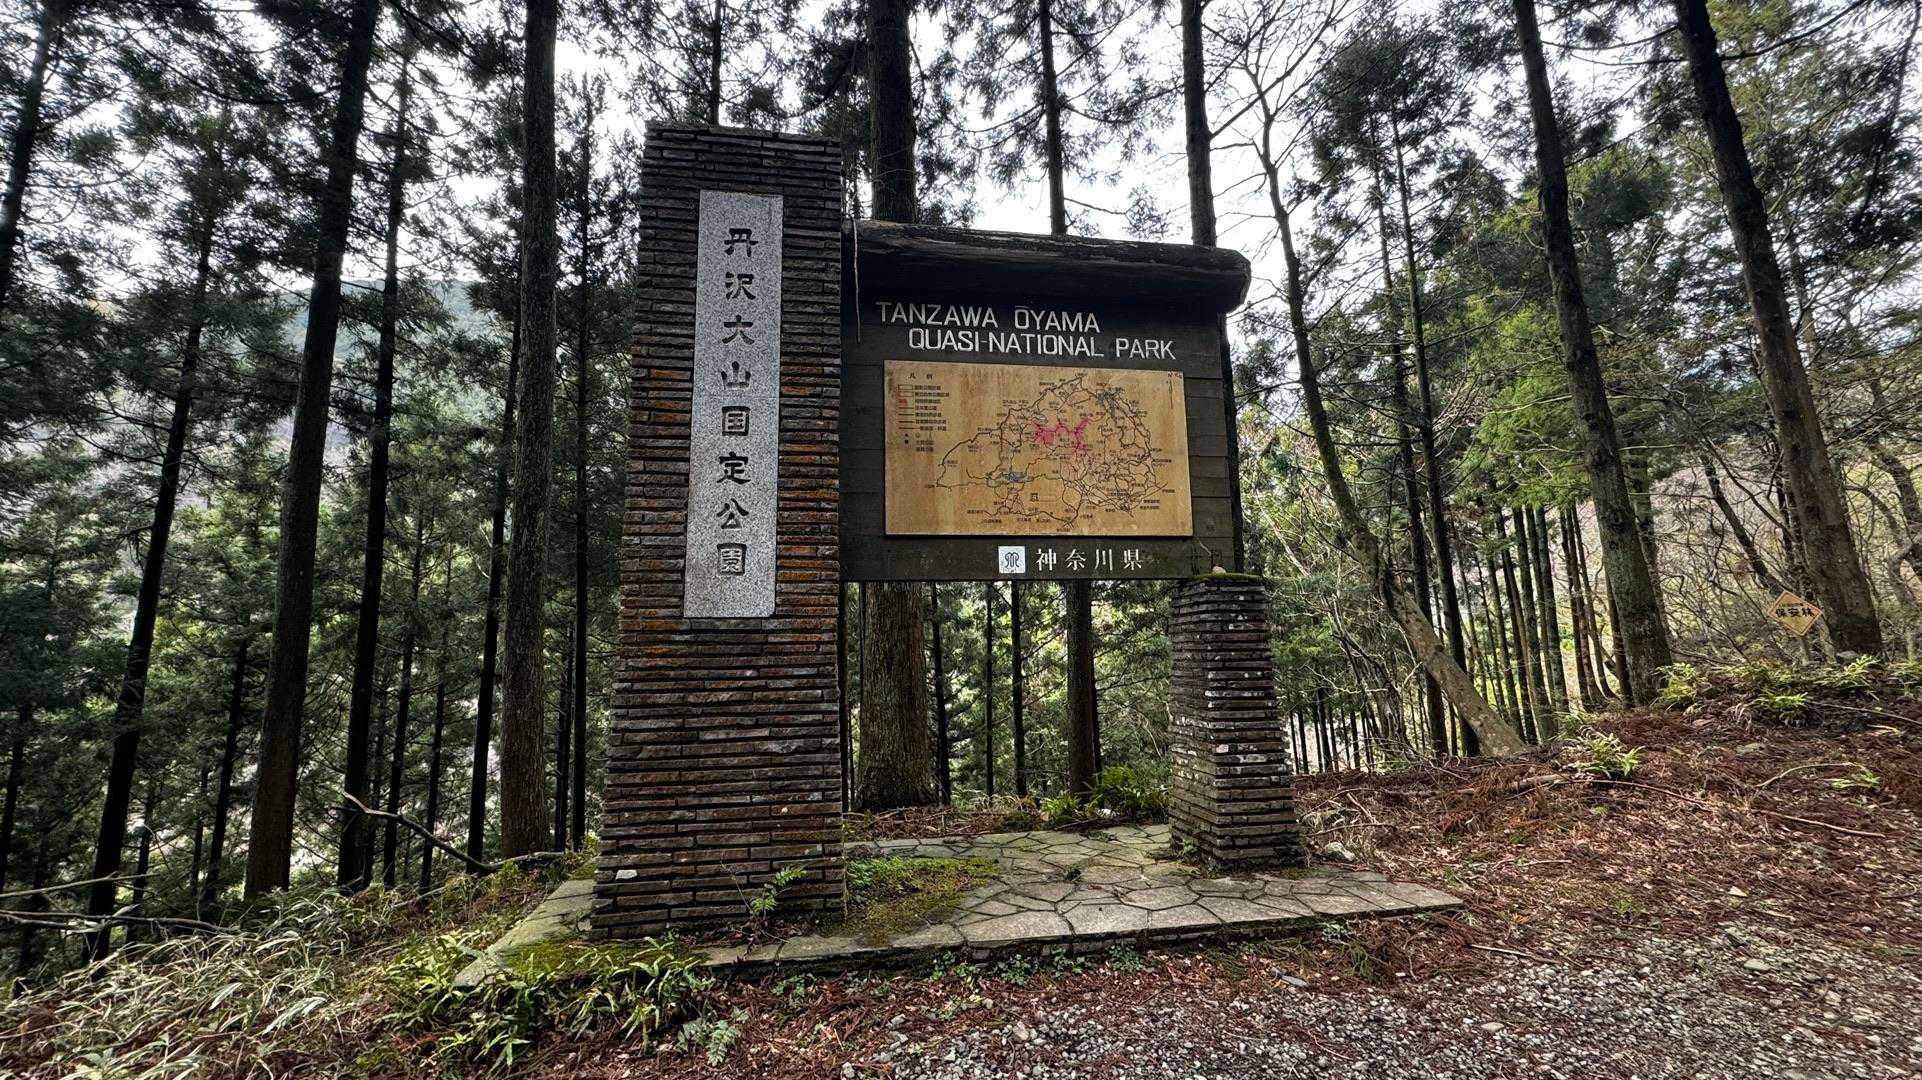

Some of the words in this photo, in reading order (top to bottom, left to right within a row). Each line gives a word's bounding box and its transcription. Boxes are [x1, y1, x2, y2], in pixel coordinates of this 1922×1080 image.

[876, 301, 998, 328] TANZAWA
[909, 328, 1104, 357] QUASI-NATIONAL
[1115, 337, 1176, 360] PARK
[716, 228, 758, 576] 丹沢大山国定公園
[1036, 548, 1143, 571] 神奈川県
